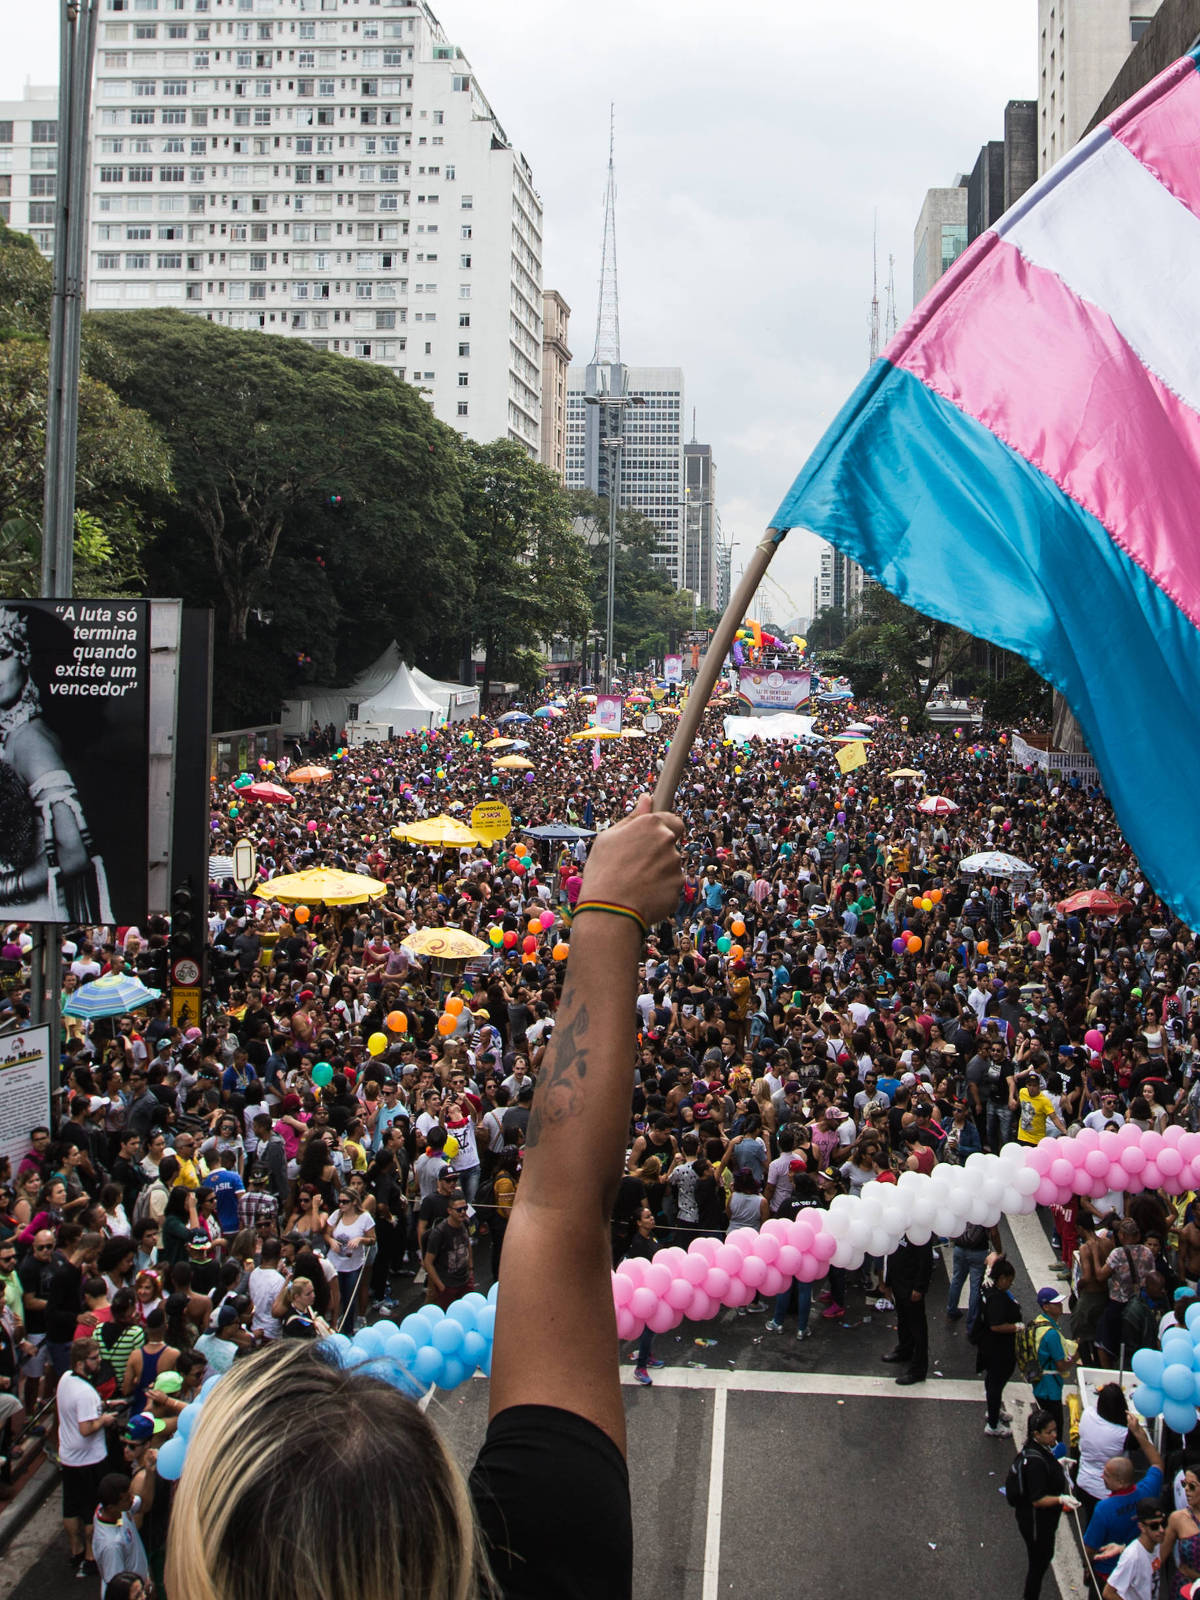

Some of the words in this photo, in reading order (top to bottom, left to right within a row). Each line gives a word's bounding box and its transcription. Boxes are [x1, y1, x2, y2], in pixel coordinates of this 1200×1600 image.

[55, 606, 76, 621] “A
[80, 606, 112, 621] luta
[116, 607, 137, 622] só
[73, 625, 137, 641] termina
[73, 644, 137, 661] quando
[55, 662, 106, 677] existe
[110, 666, 137, 678] um
[49, 681, 138, 696] vencedor”
